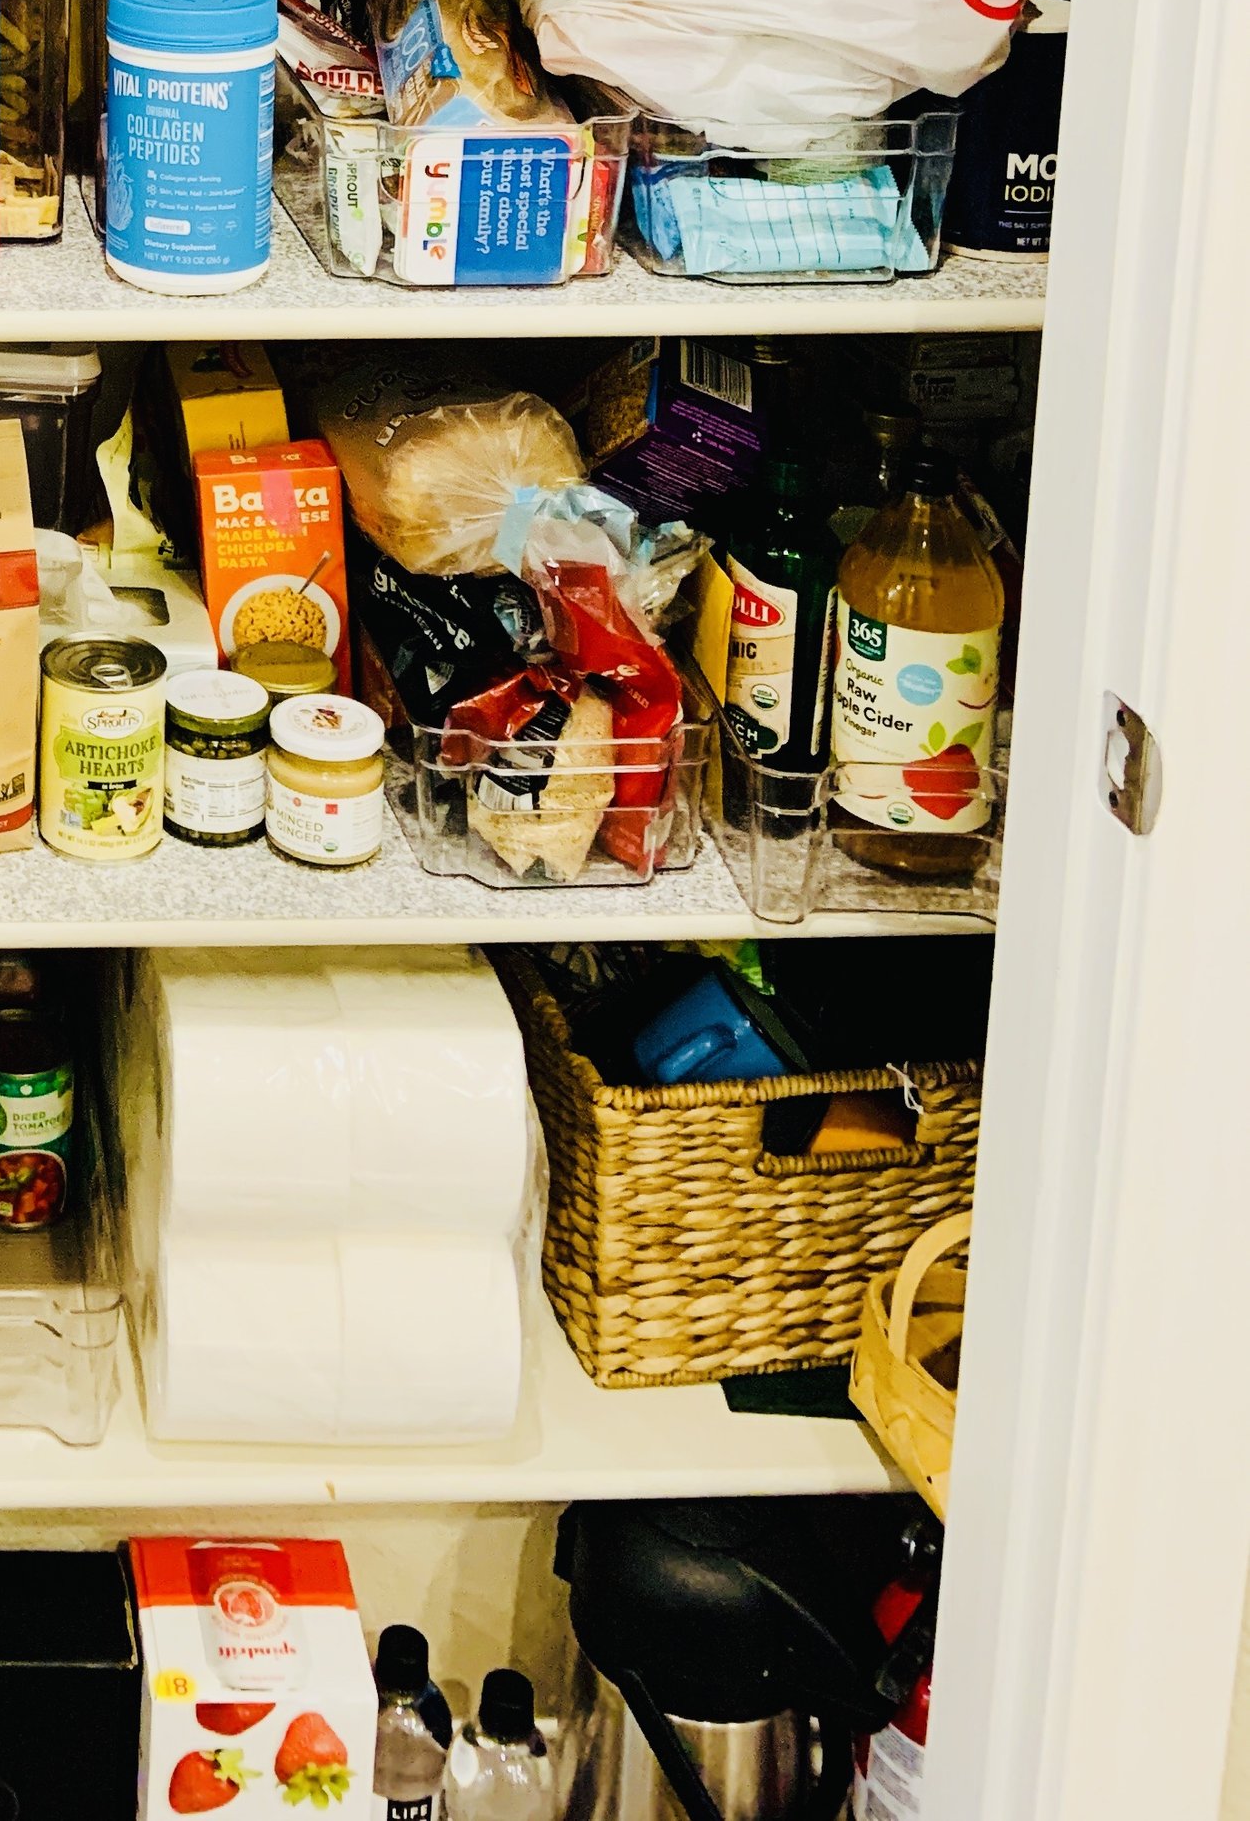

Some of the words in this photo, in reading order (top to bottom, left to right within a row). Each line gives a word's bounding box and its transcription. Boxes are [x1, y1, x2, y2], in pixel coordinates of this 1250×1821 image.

[113, 67, 143, 98] VITAL
[147, 78, 229, 111] PROTEINS
[296, 60, 384, 96] BOULDE
[145, 104, 181, 120] ORIGINAL
[127, 114, 205, 143] COLLAGEN
[128, 136, 201, 166] PEPTIDES
[159, 173, 186, 182] Collagen
[479, 147, 495, 188] your
[497, 148, 517, 195] thing
[518, 147, 534, 190] most
[538, 147, 557, 207] What's
[1006, 152, 1058, 181] MO
[1004, 185, 1053, 202] IODI
[422, 162, 451, 261] yumble
[476, 188, 495, 255] family?
[496, 196, 513, 246] about
[515, 191, 532, 252] special
[535, 208, 552, 237] the
[144, 238, 170, 250] Dietary
[171, 241, 217, 253] Supplement
[212, 484, 330, 514] Baza
[215, 517, 250, 529] MAC
[253, 515, 267, 527] &
[216, 529, 263, 543] MADE
[216, 540, 297, 556] CHICKPEA
[218, 556, 269, 570] PASTA
[850, 617, 883, 648] 365
[845, 657, 885, 687] Organic
[846, 677, 877, 704] Raw
[87, 717, 141, 730] SPROUTS
[842, 713, 878, 739] Vinegar
[863, 706, 915, 734] Cider
[65, 735, 157, 761] ARTICHOKE
[79, 757, 146, 778] HEARTS
[276, 809, 325, 833] MINCED
[276, 820, 323, 845] GINGER
[12, 1110, 47, 1122] DICED
